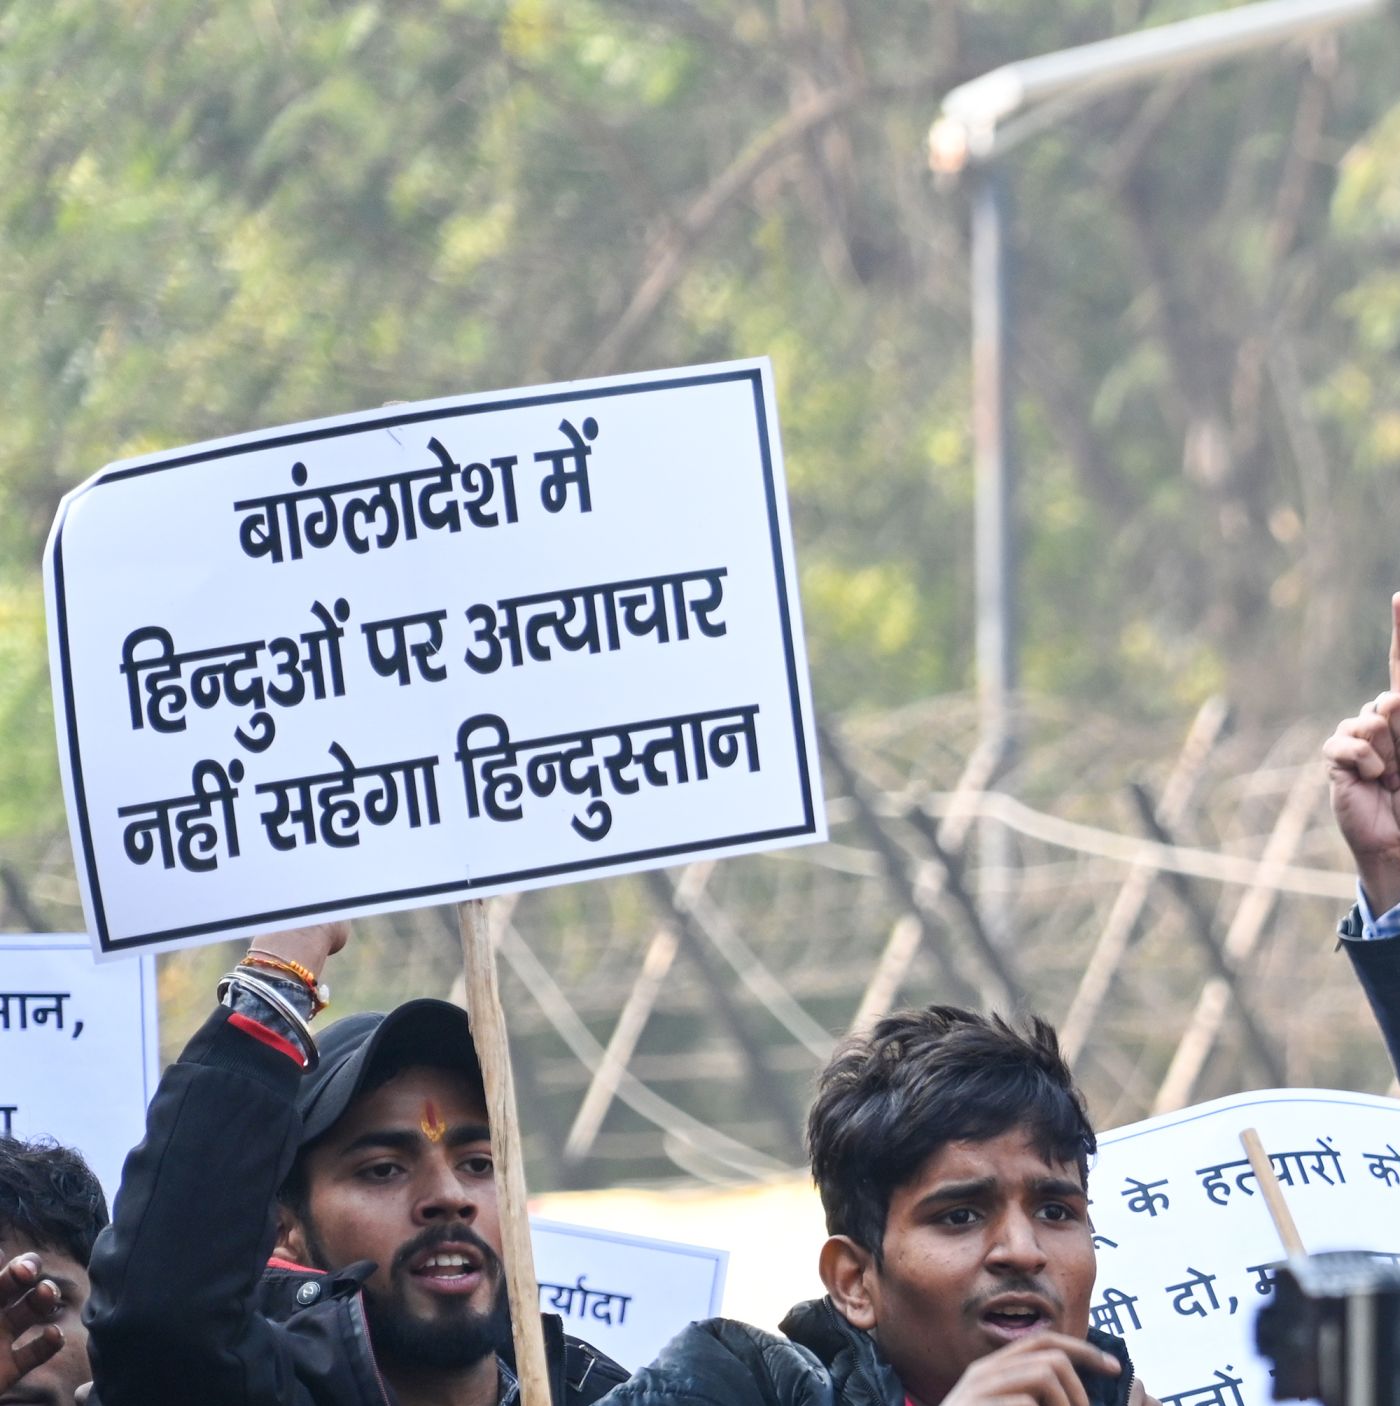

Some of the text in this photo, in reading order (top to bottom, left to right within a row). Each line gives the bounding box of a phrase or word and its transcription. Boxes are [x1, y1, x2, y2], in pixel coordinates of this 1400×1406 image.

[234, 417, 600, 564] बांग्लादेश में
[119, 566, 728, 752] हिन्दुओं पर अत्याचार
[117, 704, 762, 873] नहीं सहेगा हिन्दुस्तान
[1121, 1176, 1169, 1217] के
[1165, 1267, 1239, 1317] दो,
